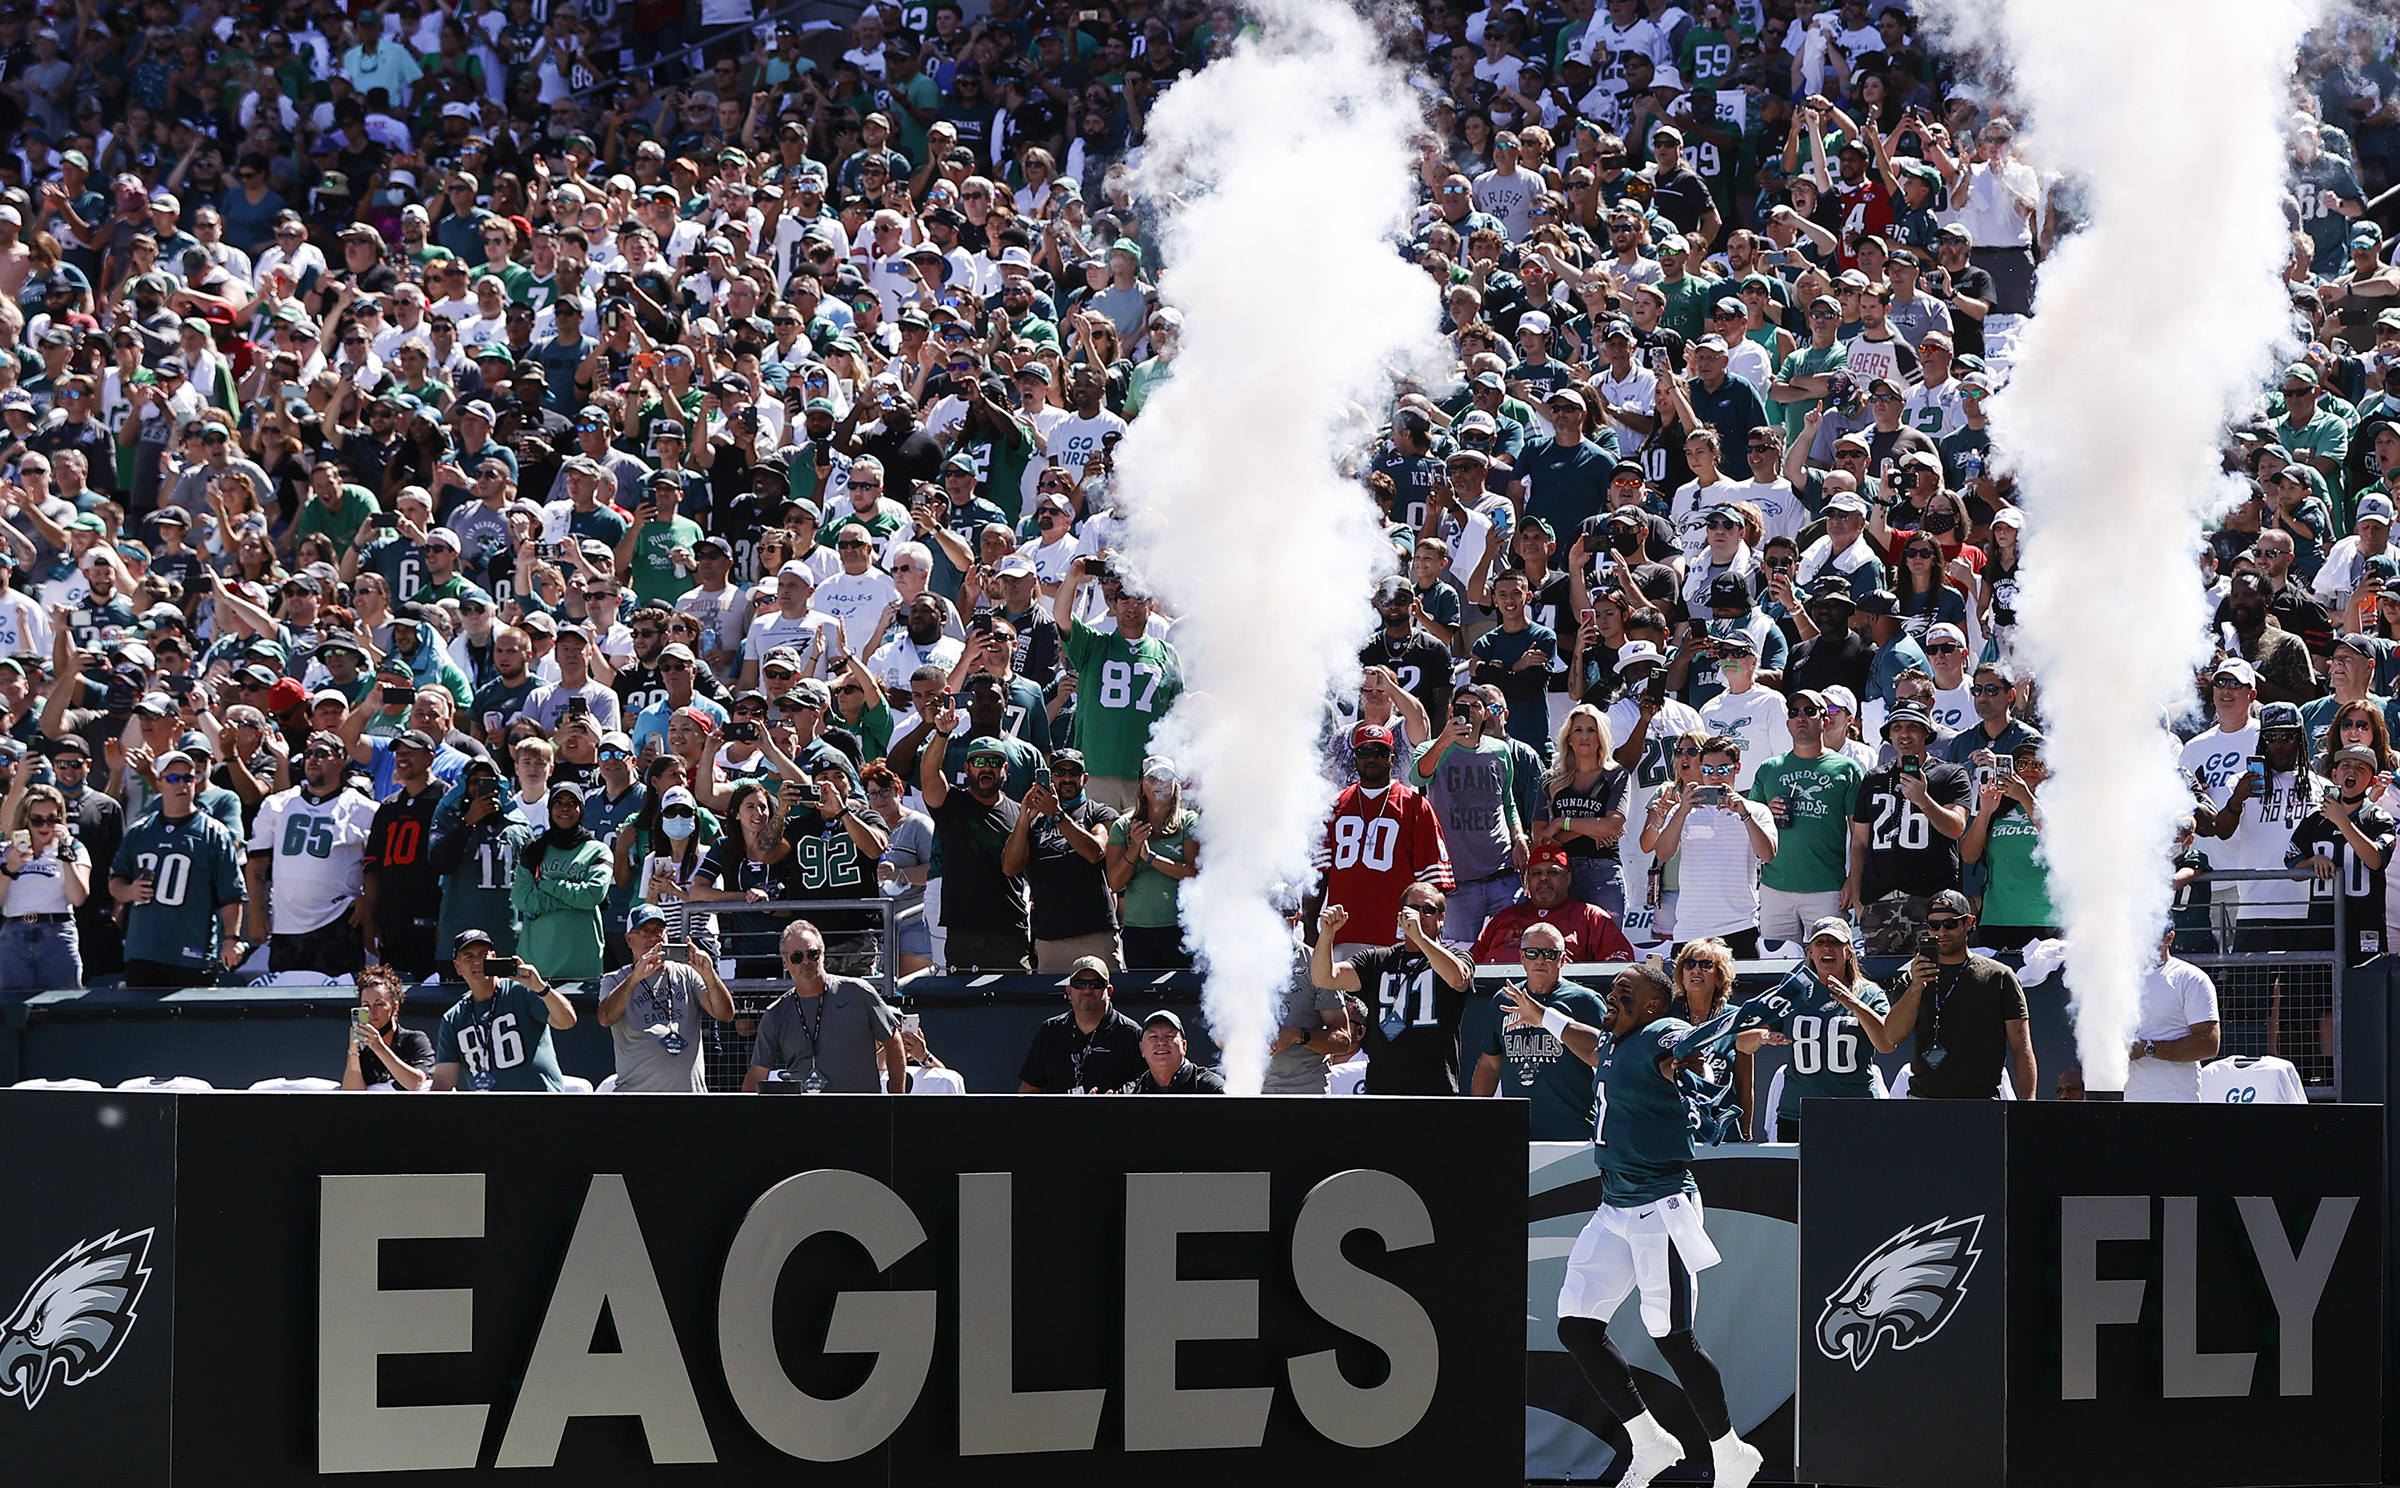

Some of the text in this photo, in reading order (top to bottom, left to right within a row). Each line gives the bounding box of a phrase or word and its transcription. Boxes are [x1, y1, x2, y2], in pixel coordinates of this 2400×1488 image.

[1695, 44, 1731, 79] 59
[1715, 104, 1734, 117] GO
[1482, 190, 1524, 208] IRISH
[527, 287, 550, 312] 7
[1660, 315, 1688, 329] GLES
[1069, 436, 1093, 450] GO
[1641, 448, 1667, 483] 10
[398, 559, 420, 602] 6
[1012, 645, 1030, 673] EAGLES
[1099, 659, 1158, 713] 87
[1778, 769, 1835, 790] BIRDS OF
[2205, 752, 2240, 772] GO
[1556, 798, 1602, 813] SUNDAYS
[1560, 809, 1577, 819] ARE
[1872, 792, 1931, 852] 26
[282, 813, 336, 859] 65
[384, 820, 421, 867] 10
[1334, 814, 1400, 872] 80
[473, 843, 514, 890] 11
[540, 858, 585, 881] AGLES
[796, 835, 862, 891] 92
[645, 1007, 684, 1025] EAGLES
[1378, 970, 1440, 1028] 91
[457, 1012, 524, 1080] 86
[1503, 1035, 1565, 1058] EAGLES
[1792, 1013, 1859, 1077] 86
[2225, 1086, 2256, 1104] GO
[2060, 1195, 2360, 1401] FLY
[318, 1168, 1439, 1475] EAGLES
